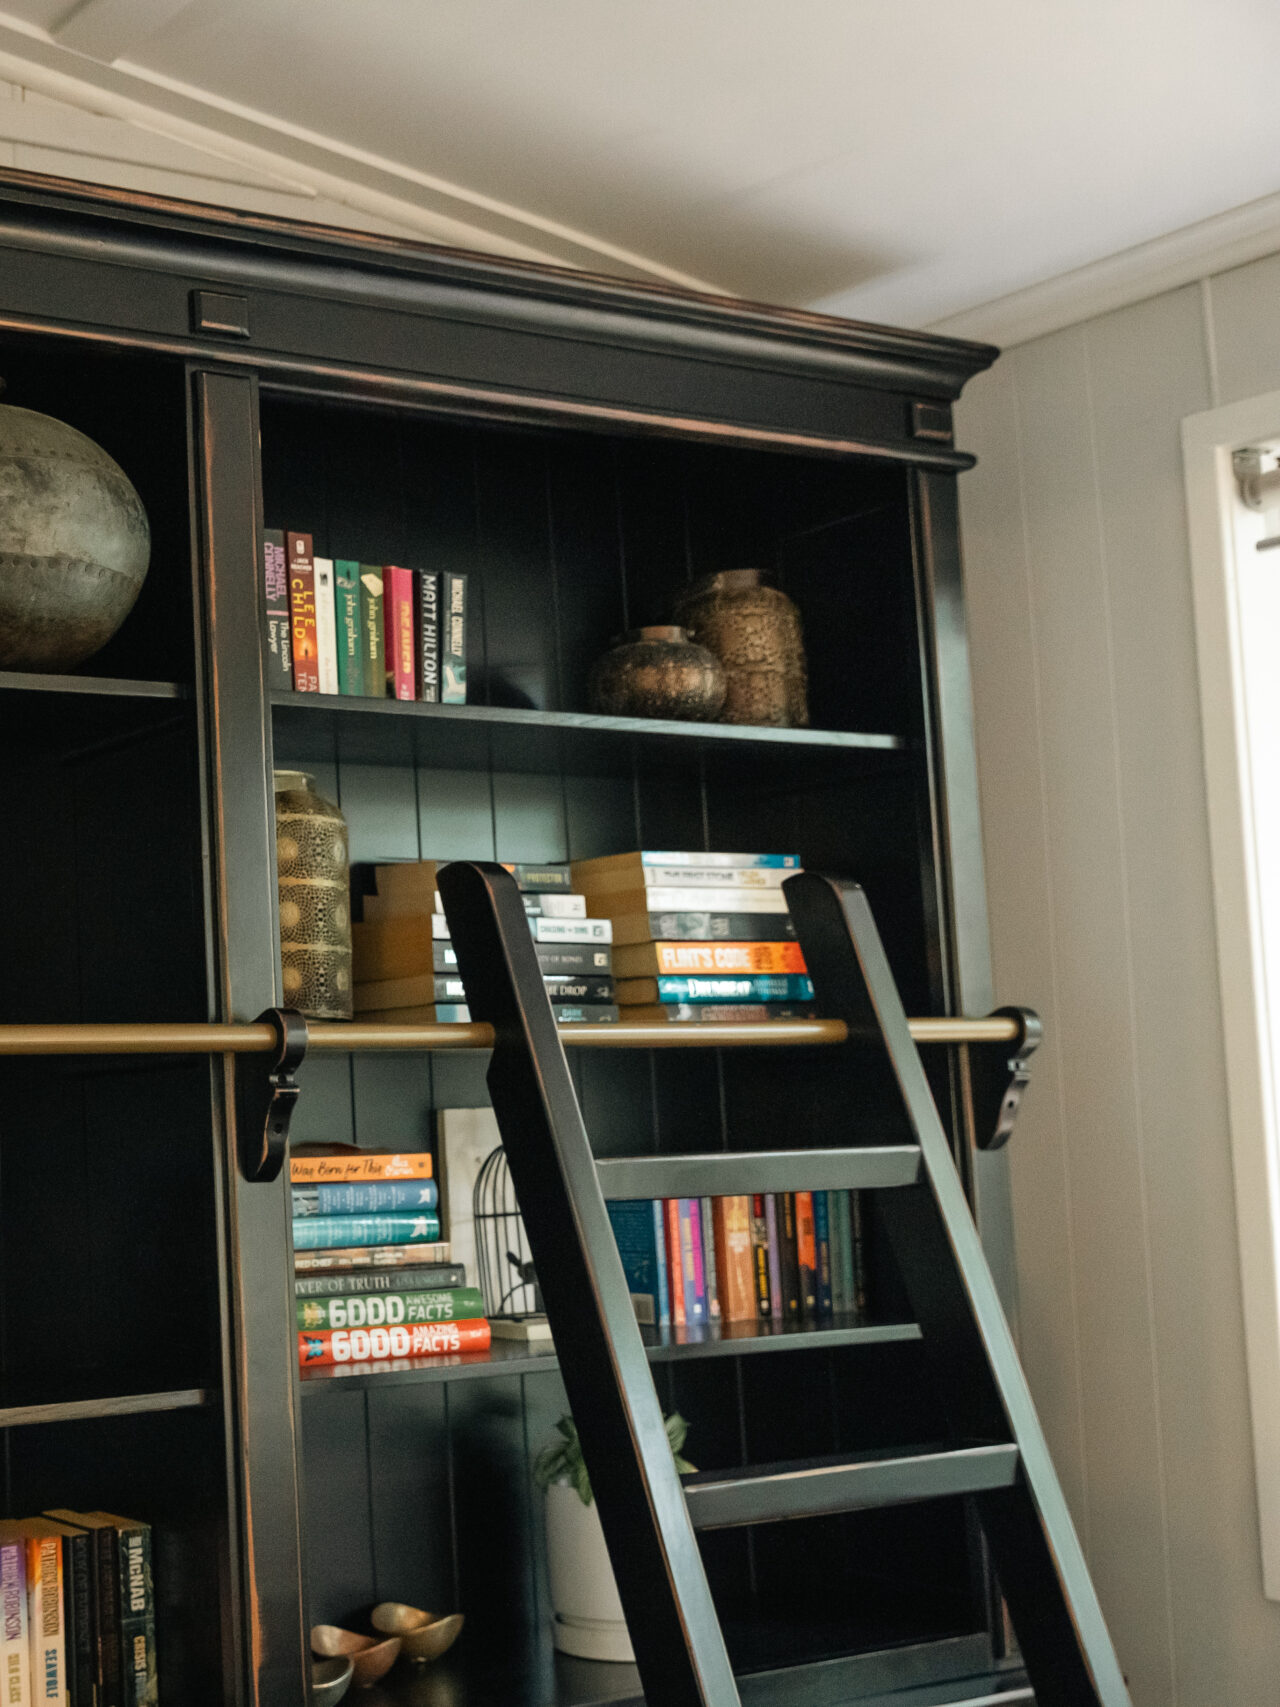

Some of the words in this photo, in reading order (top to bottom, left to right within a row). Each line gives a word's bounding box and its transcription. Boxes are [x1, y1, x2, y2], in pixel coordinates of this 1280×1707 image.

[264, 542, 277, 602] CONNELLY
[274, 546, 286, 598] MICHAEL
[291, 578, 306, 639] CHILD
[303, 590, 315, 627] LEE
[344, 593, 357, 616] john
[367, 596, 379, 619] john
[422, 574, 437, 621] MATT
[268, 620, 278, 653] Lawyer
[344, 616, 358, 656] grisham
[367, 620, 380, 659] grisham
[423, 623, 437, 684] HILTON
[281, 640, 291, 671] Lincoln
[317, 1161, 342, 1175] Born
[344, 1163, 360, 1180] for
[295, 1280, 325, 1294] IVER
[327, 1278, 345, 1292] OF
[347, 1275, 390, 1291] TRUTH
[406, 1292, 454, 1305] AWESOME
[328, 1295, 405, 1329] 6000
[407, 1303, 454, 1321] FACTS
[412, 1323, 459, 1338] AMAZING
[331, 1326, 411, 1362] 6000
[413, 1334, 461, 1353] FACTS
[1, 1545, 19, 1589] PATRICK
[41, 1542, 57, 1586] PATRICK
[128, 1547, 146, 1612] McNAB
[4, 1587, 21, 1641] ROBINSON
[42, 1585, 60, 1637] ROBINSON
[133, 1635, 147, 1671] CRISIS
[45, 1649, 58, 1699] SEAWOLF
